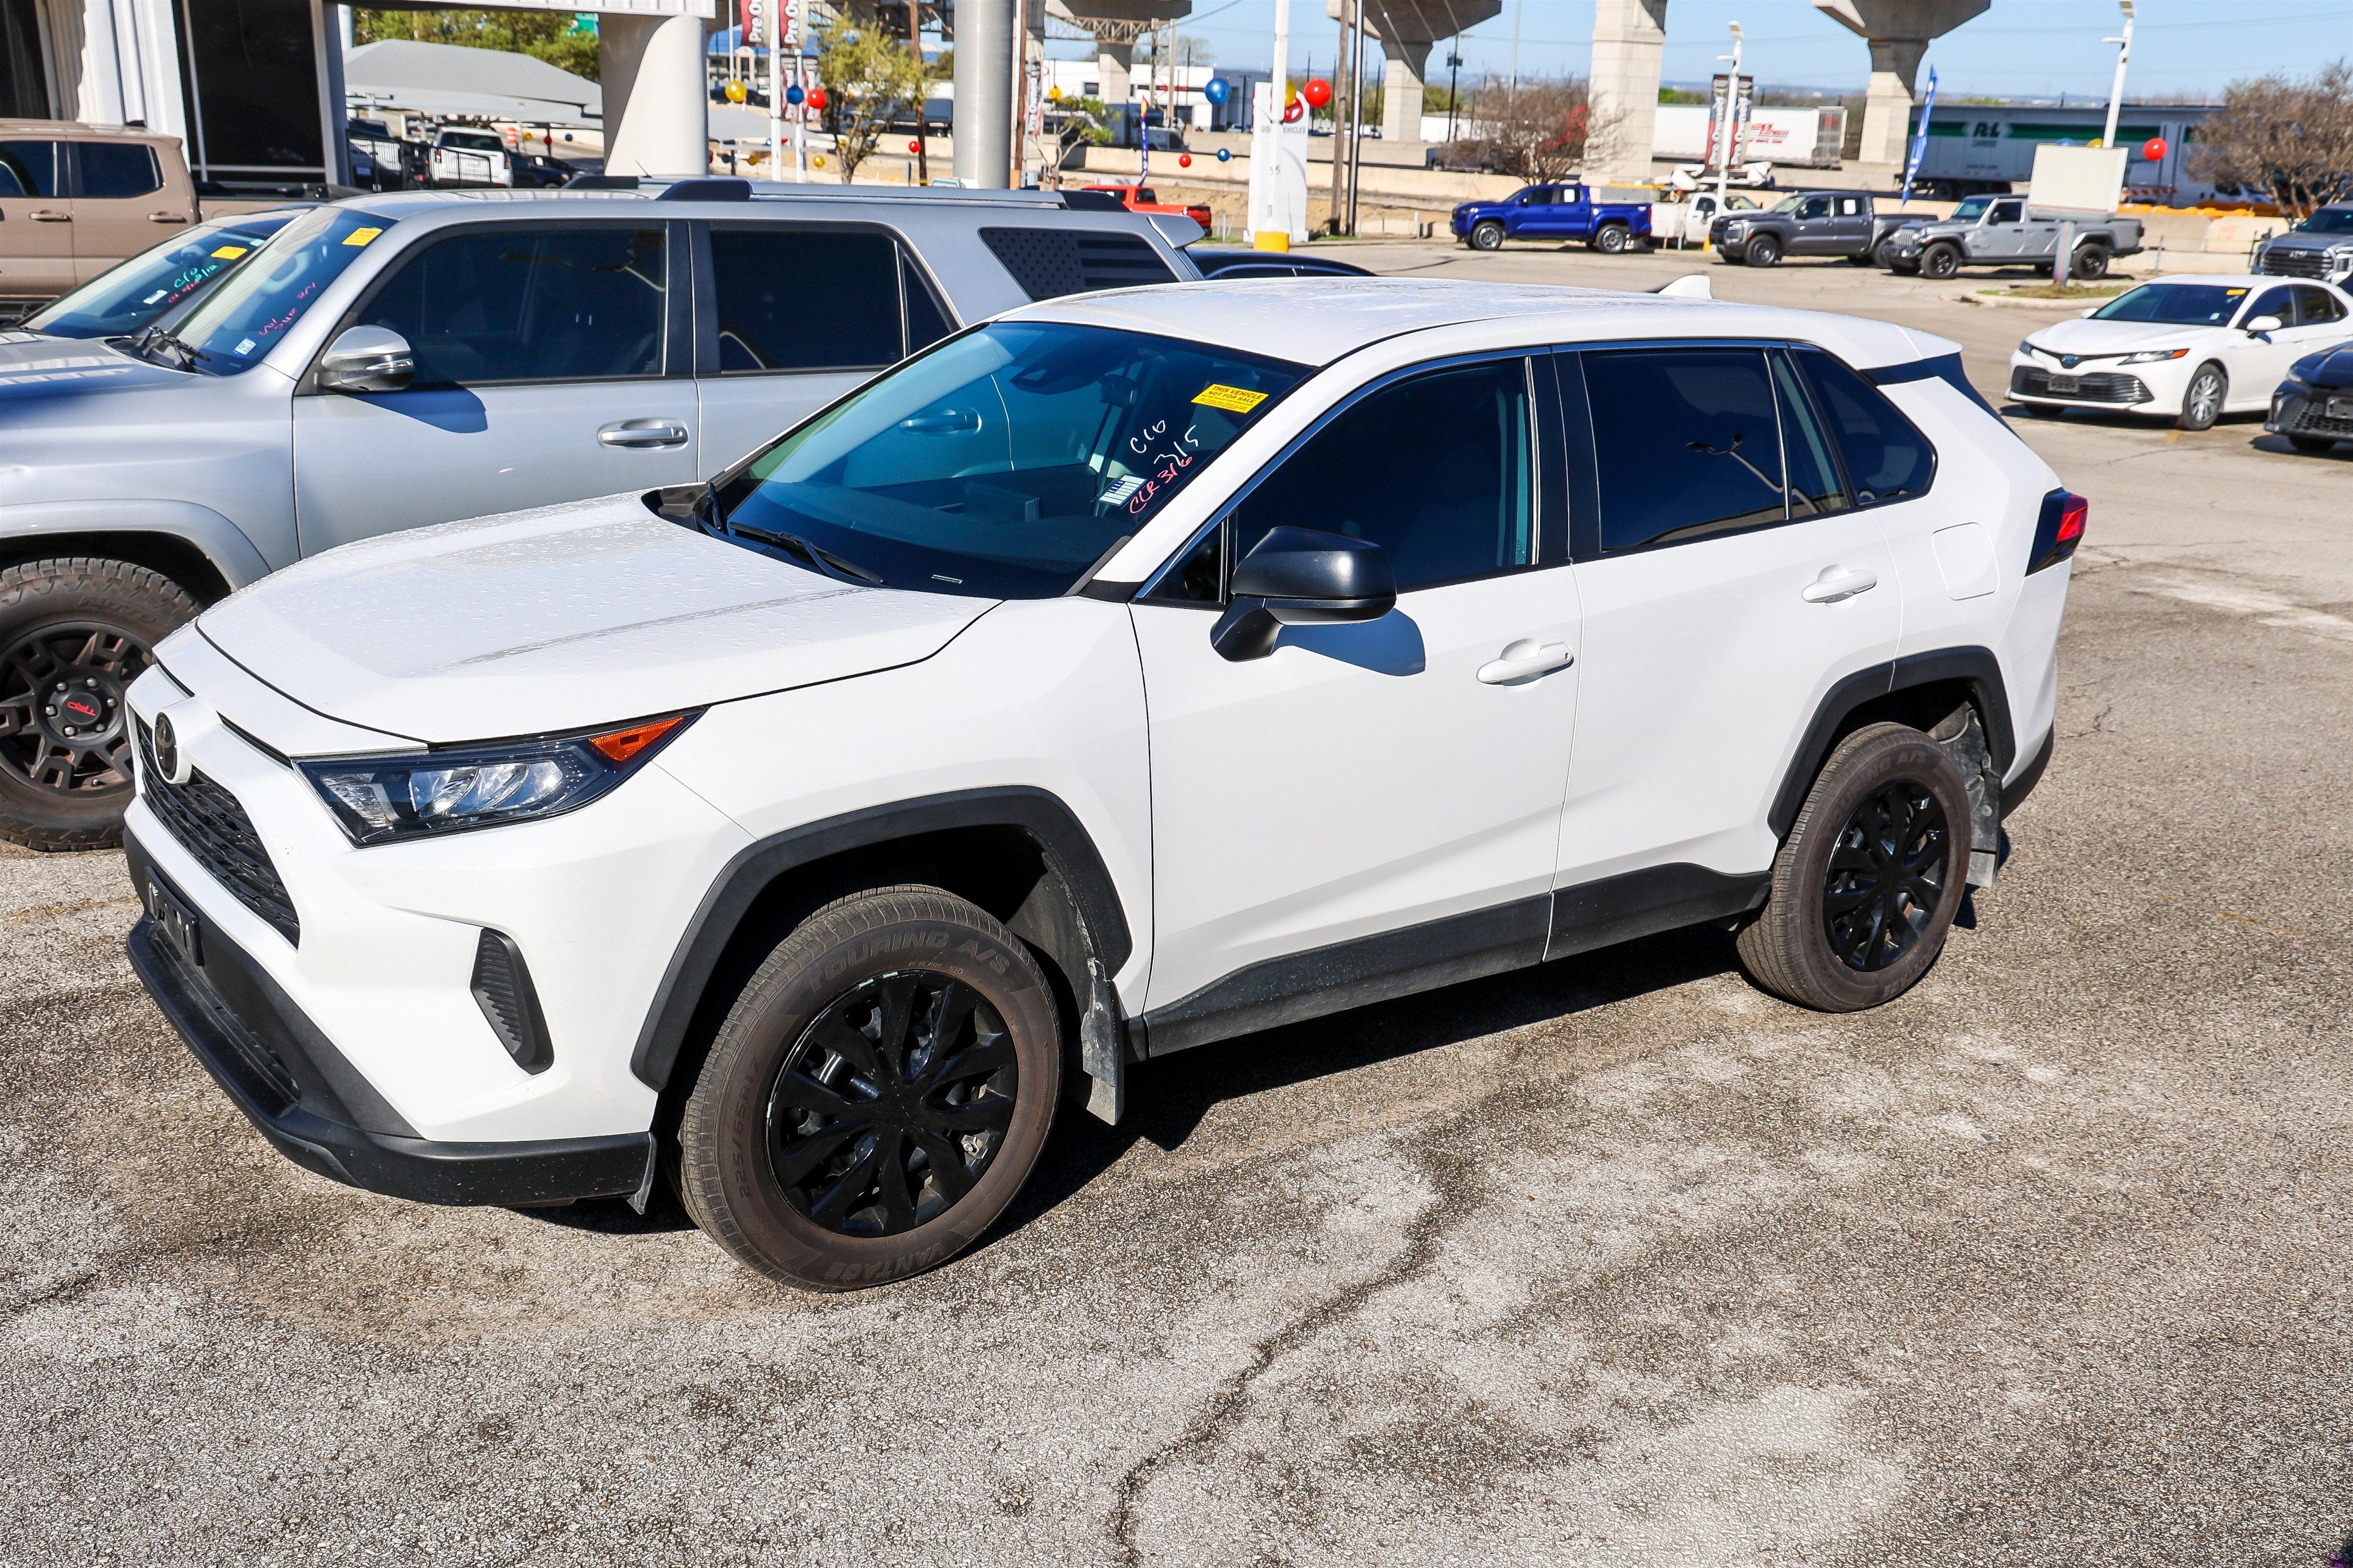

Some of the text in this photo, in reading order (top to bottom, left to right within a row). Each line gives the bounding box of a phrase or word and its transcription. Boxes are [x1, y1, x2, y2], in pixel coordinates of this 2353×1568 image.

[749, 17, 763, 43] Pre
[784, 18, 799, 44] Pre
[1230, 389, 1264, 400] VEHICLE
[79, 596, 157, 624] NITTO
[805, 930, 1011, 993] TOURING A/S
[732, 1055, 758, 1199] 225/65R17
[824, 1242, 945, 1280] VANTAGE
